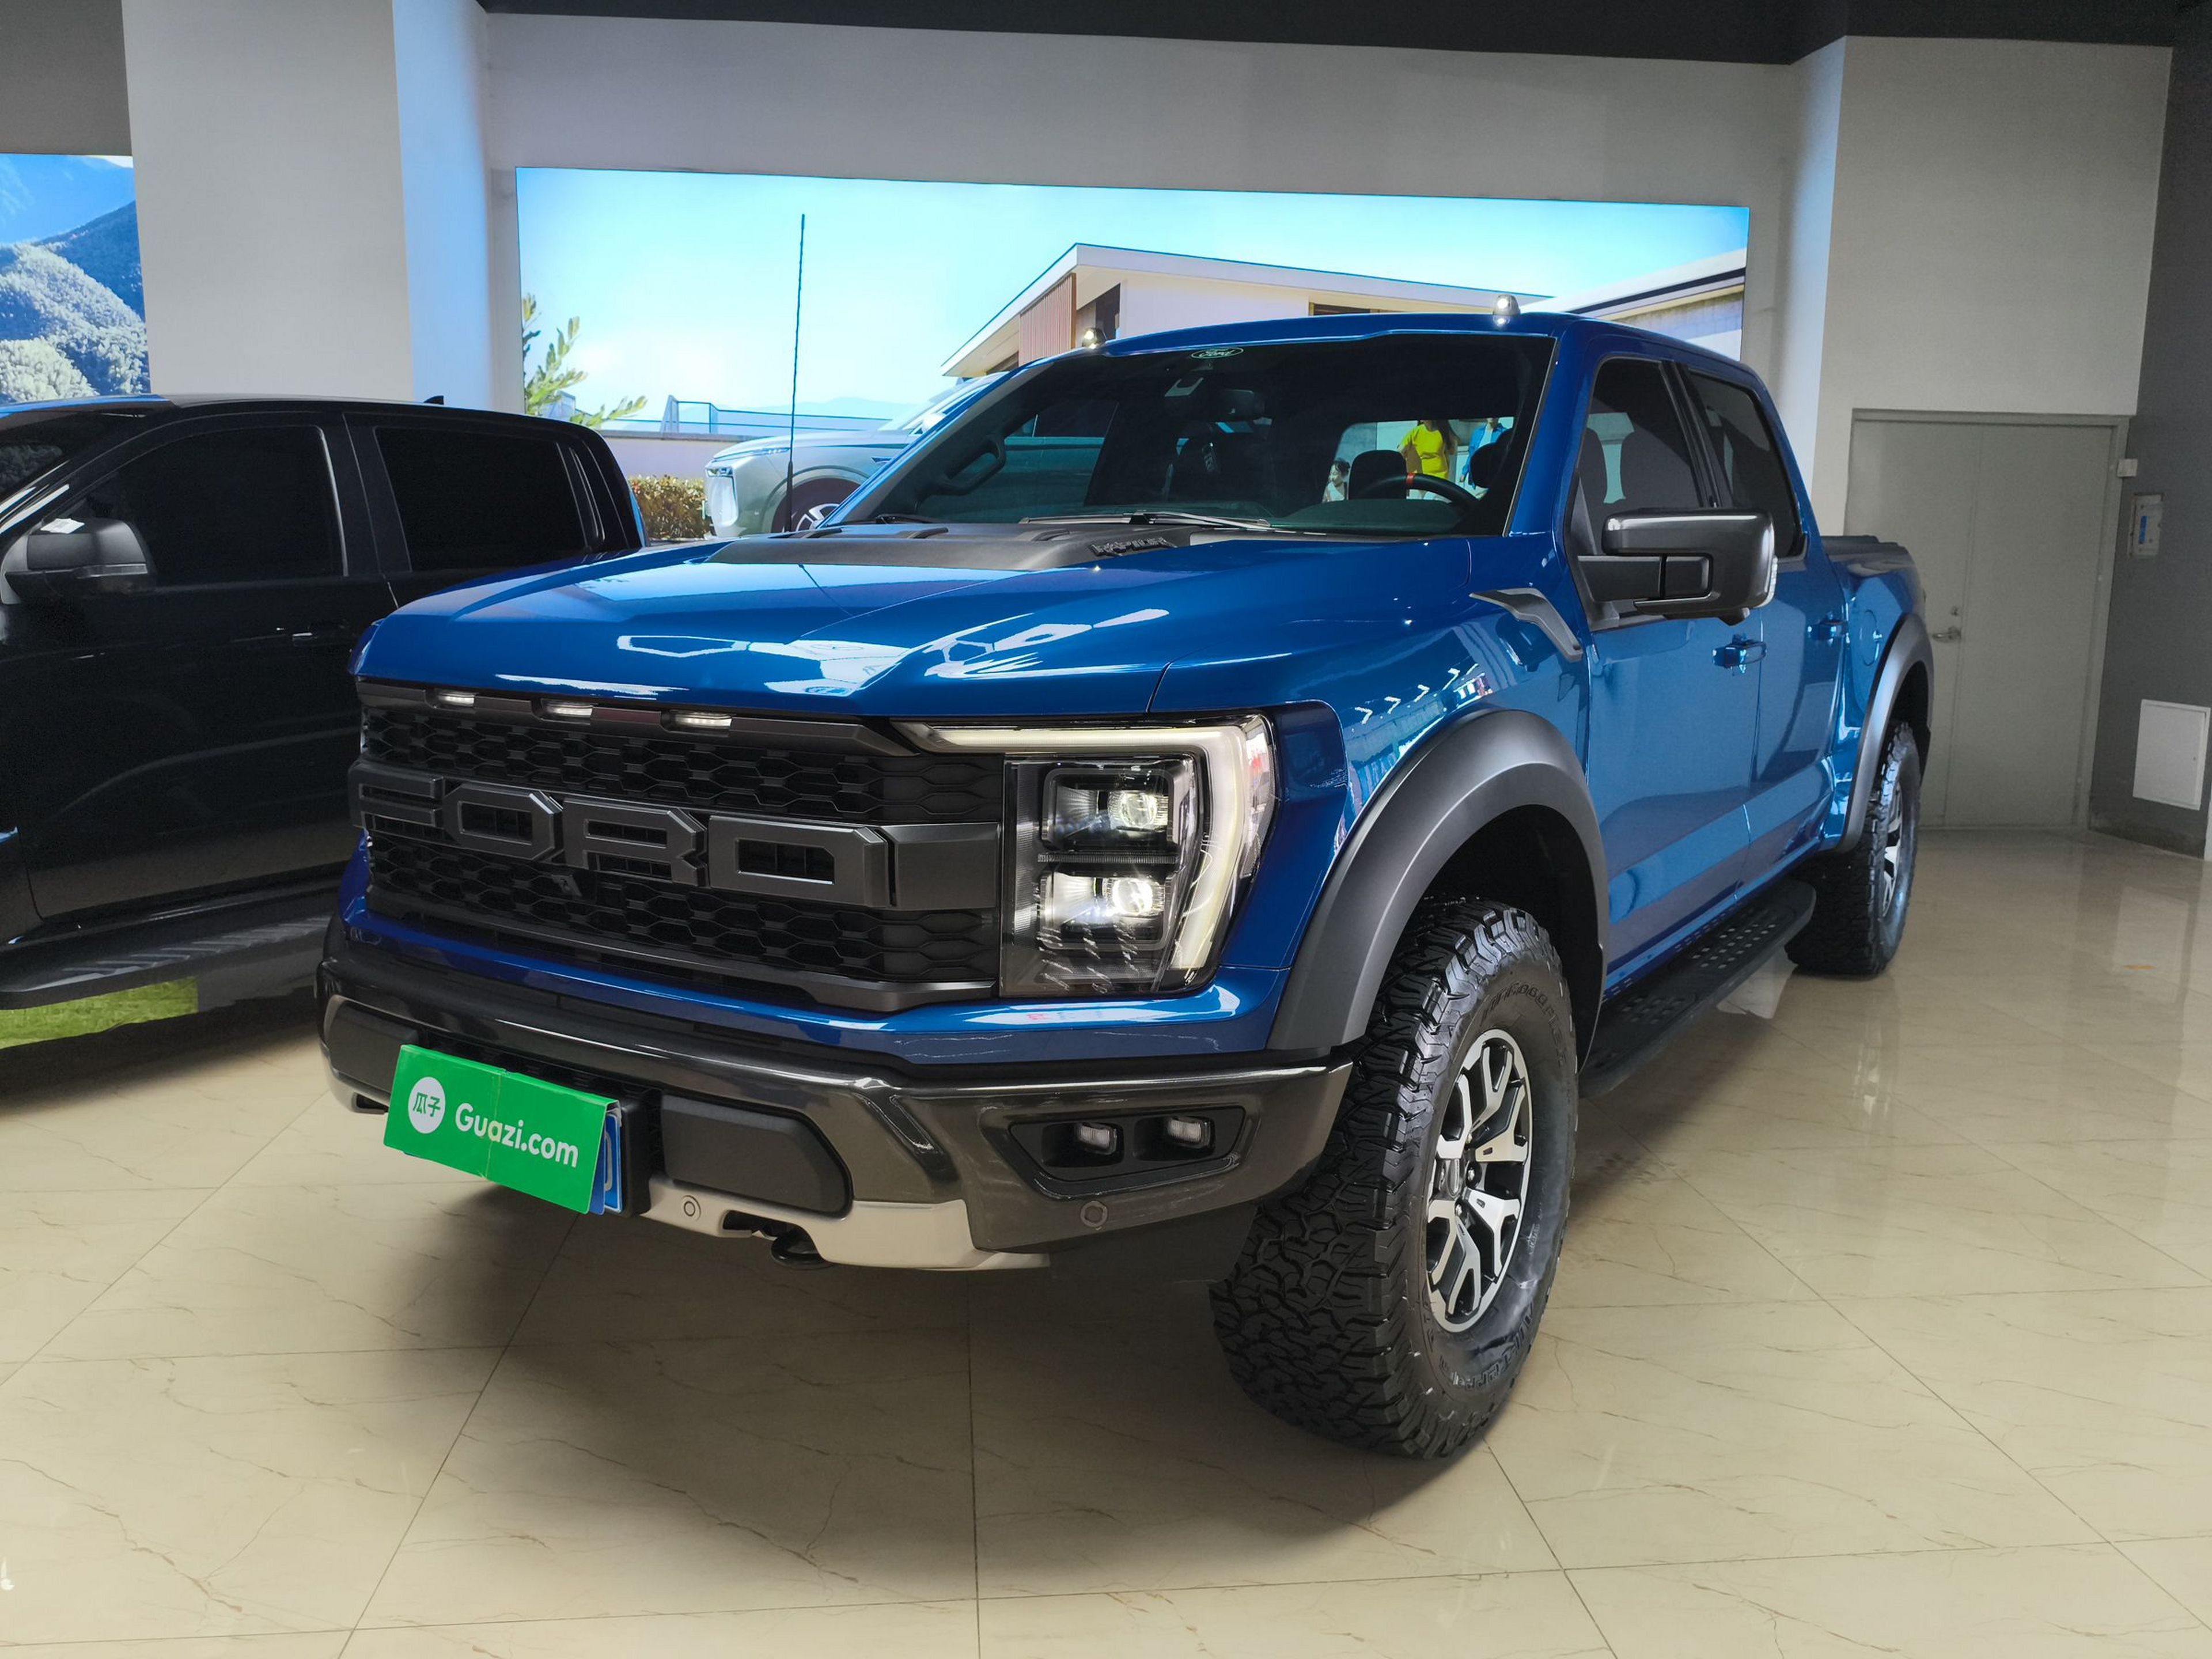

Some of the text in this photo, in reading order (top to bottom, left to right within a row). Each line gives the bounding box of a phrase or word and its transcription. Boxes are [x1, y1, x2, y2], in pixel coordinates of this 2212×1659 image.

[348, 760, 888, 910] FORD
[412, 1092, 441, 1118] 瓜子
[455, 1103, 579, 1168] Guazi.com
